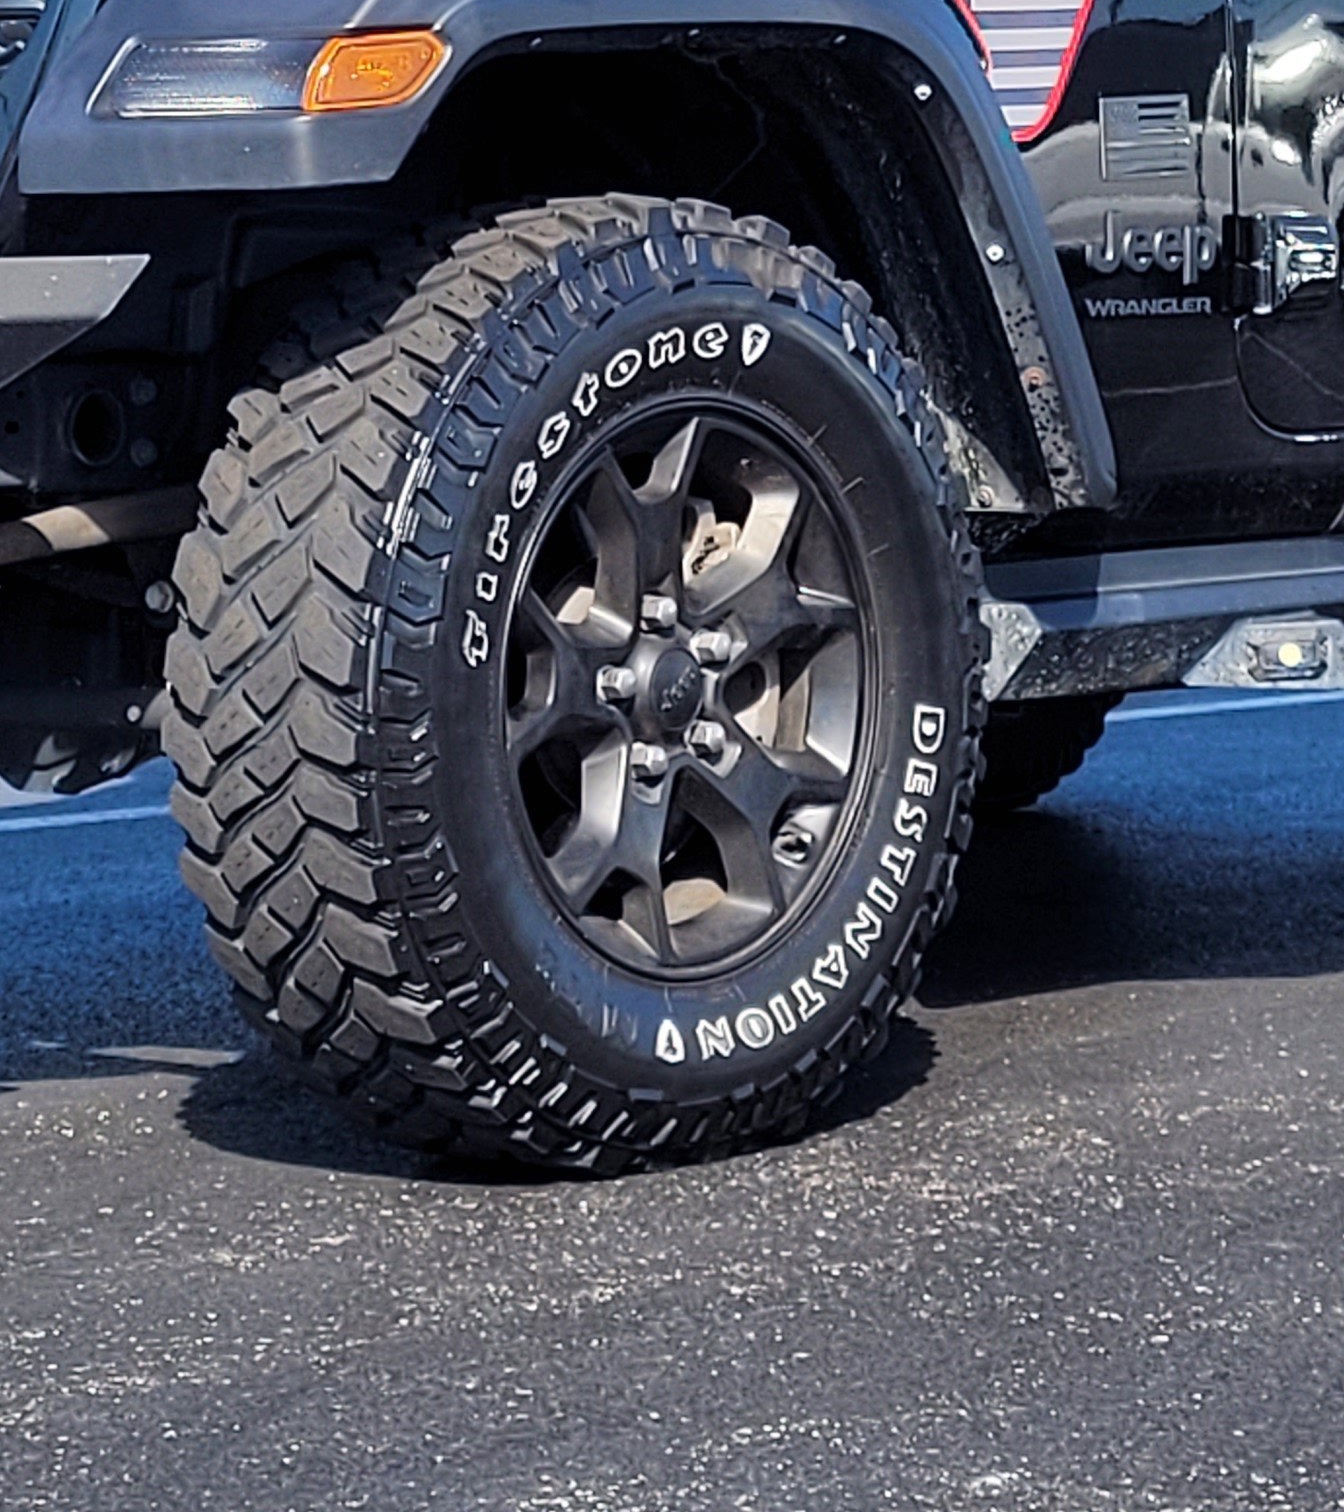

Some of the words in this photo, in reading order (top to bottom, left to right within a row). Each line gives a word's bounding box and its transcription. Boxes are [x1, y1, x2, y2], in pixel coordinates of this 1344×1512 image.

[1084, 210, 1217, 286] Jeep
[1084, 296, 1212, 318] WRANGLER
[694, 703, 946, 1061] DESTINATION
